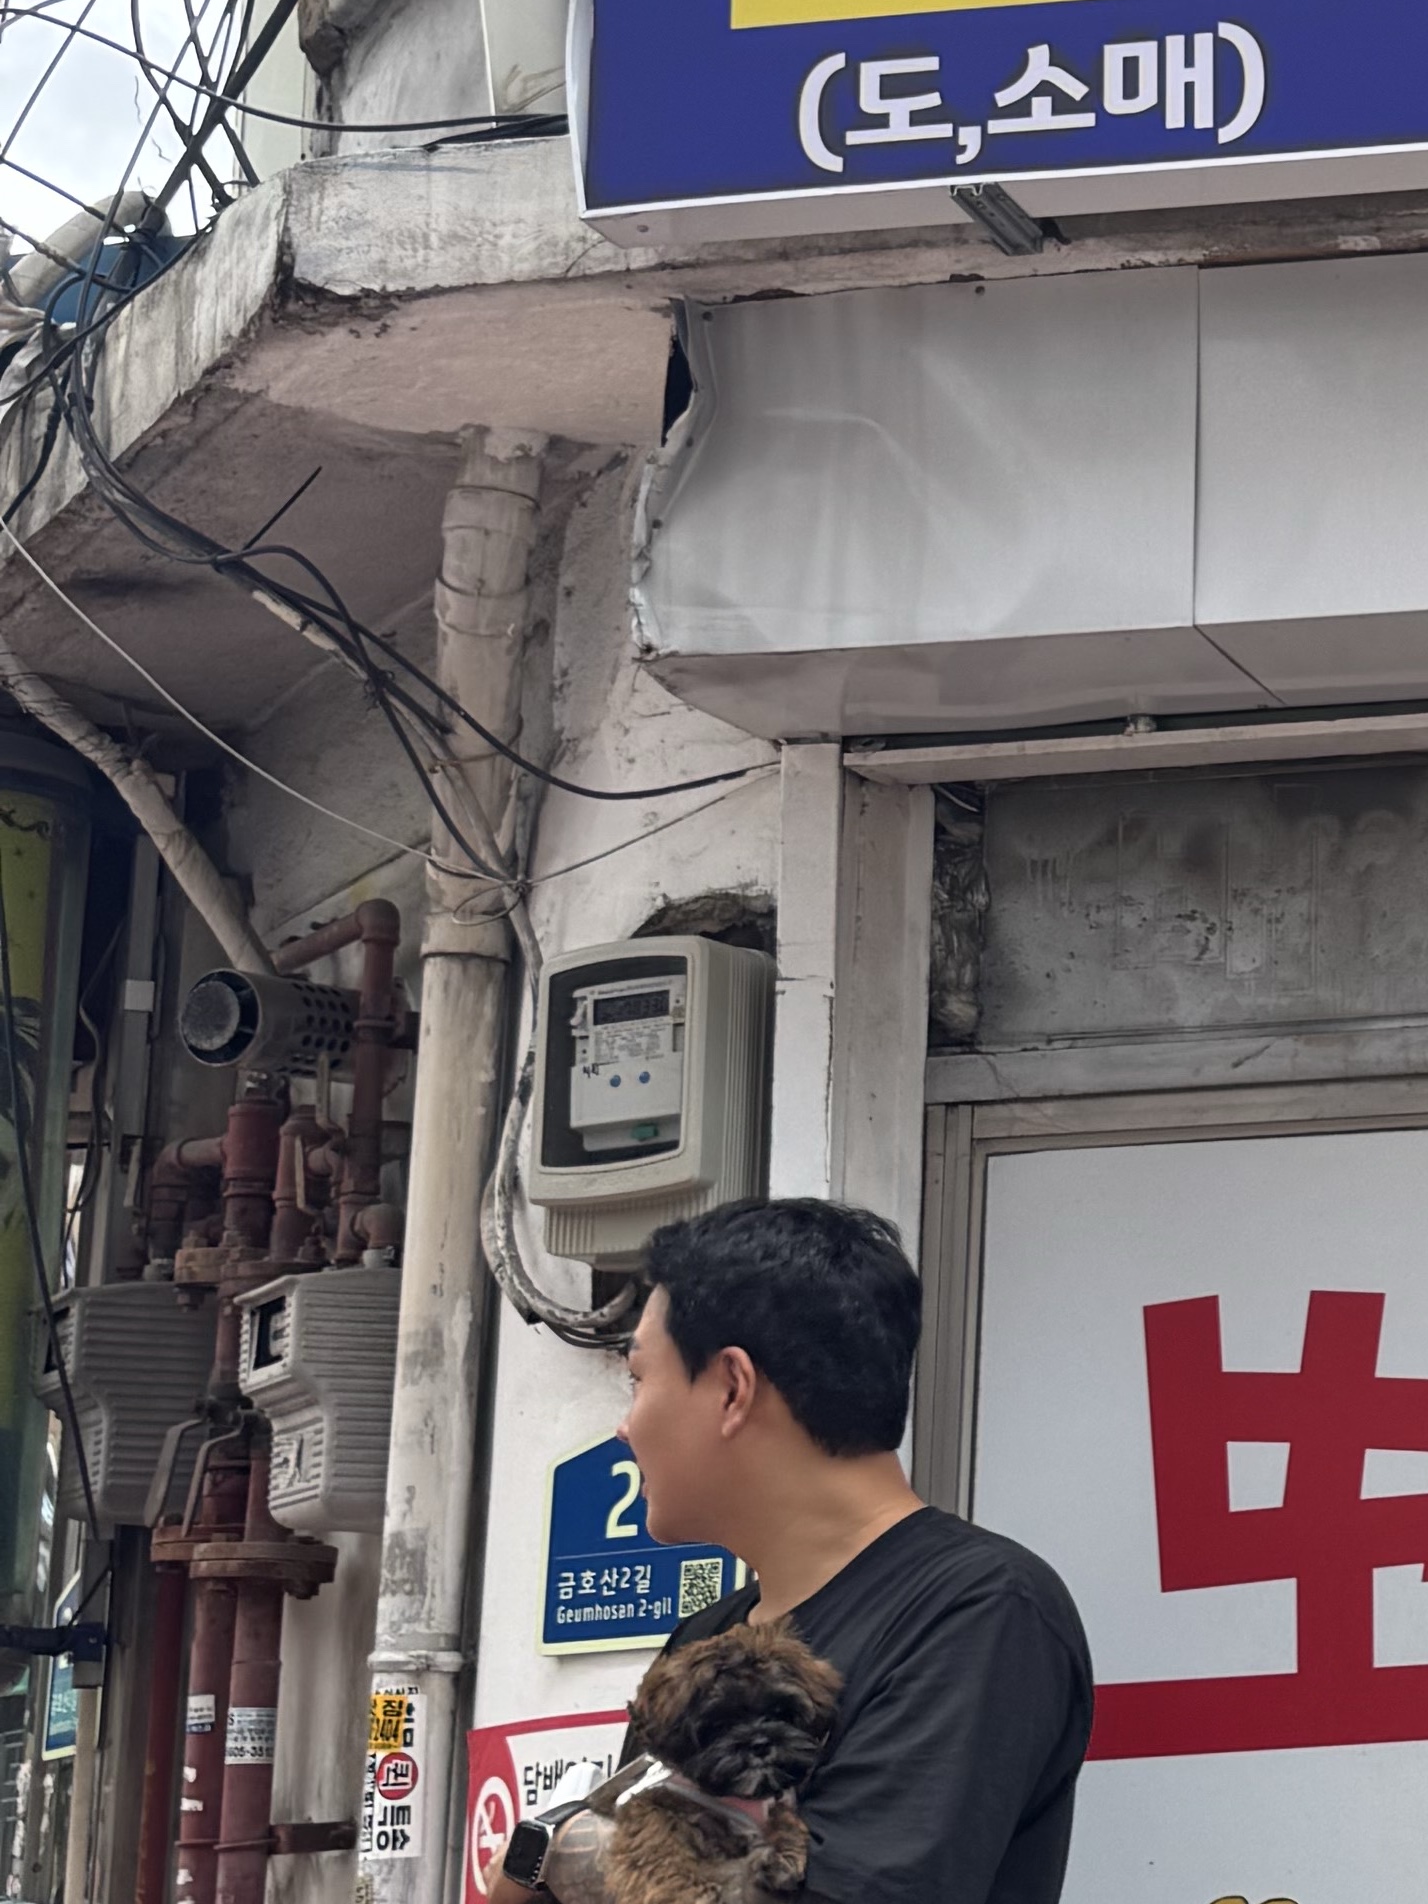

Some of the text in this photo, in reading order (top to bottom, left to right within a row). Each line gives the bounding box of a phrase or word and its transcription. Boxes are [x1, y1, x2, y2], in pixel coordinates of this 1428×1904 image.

[799, 20, 1266, 174] (도,소매)
[557, 1564, 652, 1601] 금호산2길
[556, 1596, 672, 1624] Geumhosan 2-gil
